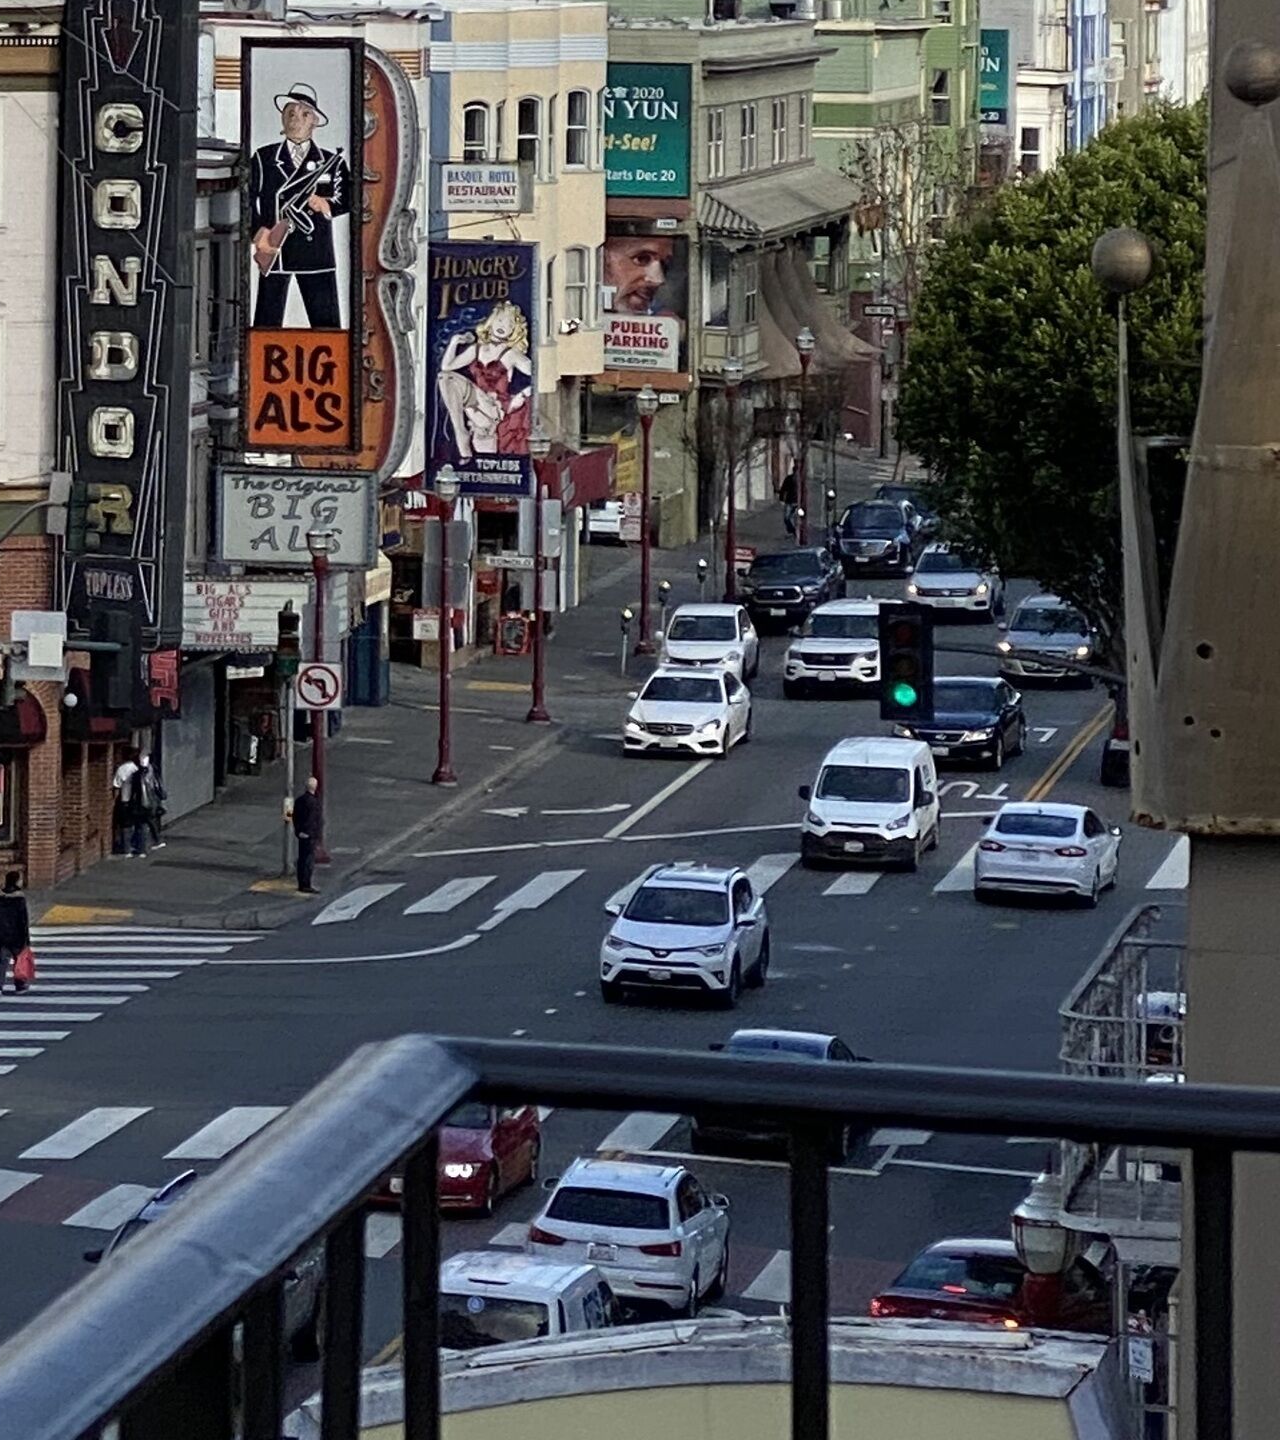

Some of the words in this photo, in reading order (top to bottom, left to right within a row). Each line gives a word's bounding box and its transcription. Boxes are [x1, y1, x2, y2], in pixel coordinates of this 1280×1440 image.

[632, 86, 665, 100] 2020
[622, 100, 679, 120] YUN
[489, 170, 516, 182] HOTEL
[605, 169, 634, 181] tarts
[636, 169, 658, 181] Dec
[659, 169, 677, 182] 20
[447, 185, 517, 196] RESTAURANT
[433, 255, 527, 280] HUNGRY
[454, 280, 510, 305] CLUB
[87, 102, 145, 535] CONDOR
[611, 321, 663, 336] PUBLIC
[604, 334, 669, 350] PARKING
[263, 344, 338, 386] BIG
[254, 388, 344, 434] AL'S
[232, 476, 268, 491] The
[271, 478, 360, 495] Original
[457, 471, 523, 485] ERTAINMENT
[247, 493, 339, 524] BIG
[84, 570, 134, 601] TOPLESS
[196, 584, 216, 595] BIG
[205, 595, 245, 608] CIGARS
[209, 608, 240, 620] GIFTS
[212, 620, 236, 632] AND
